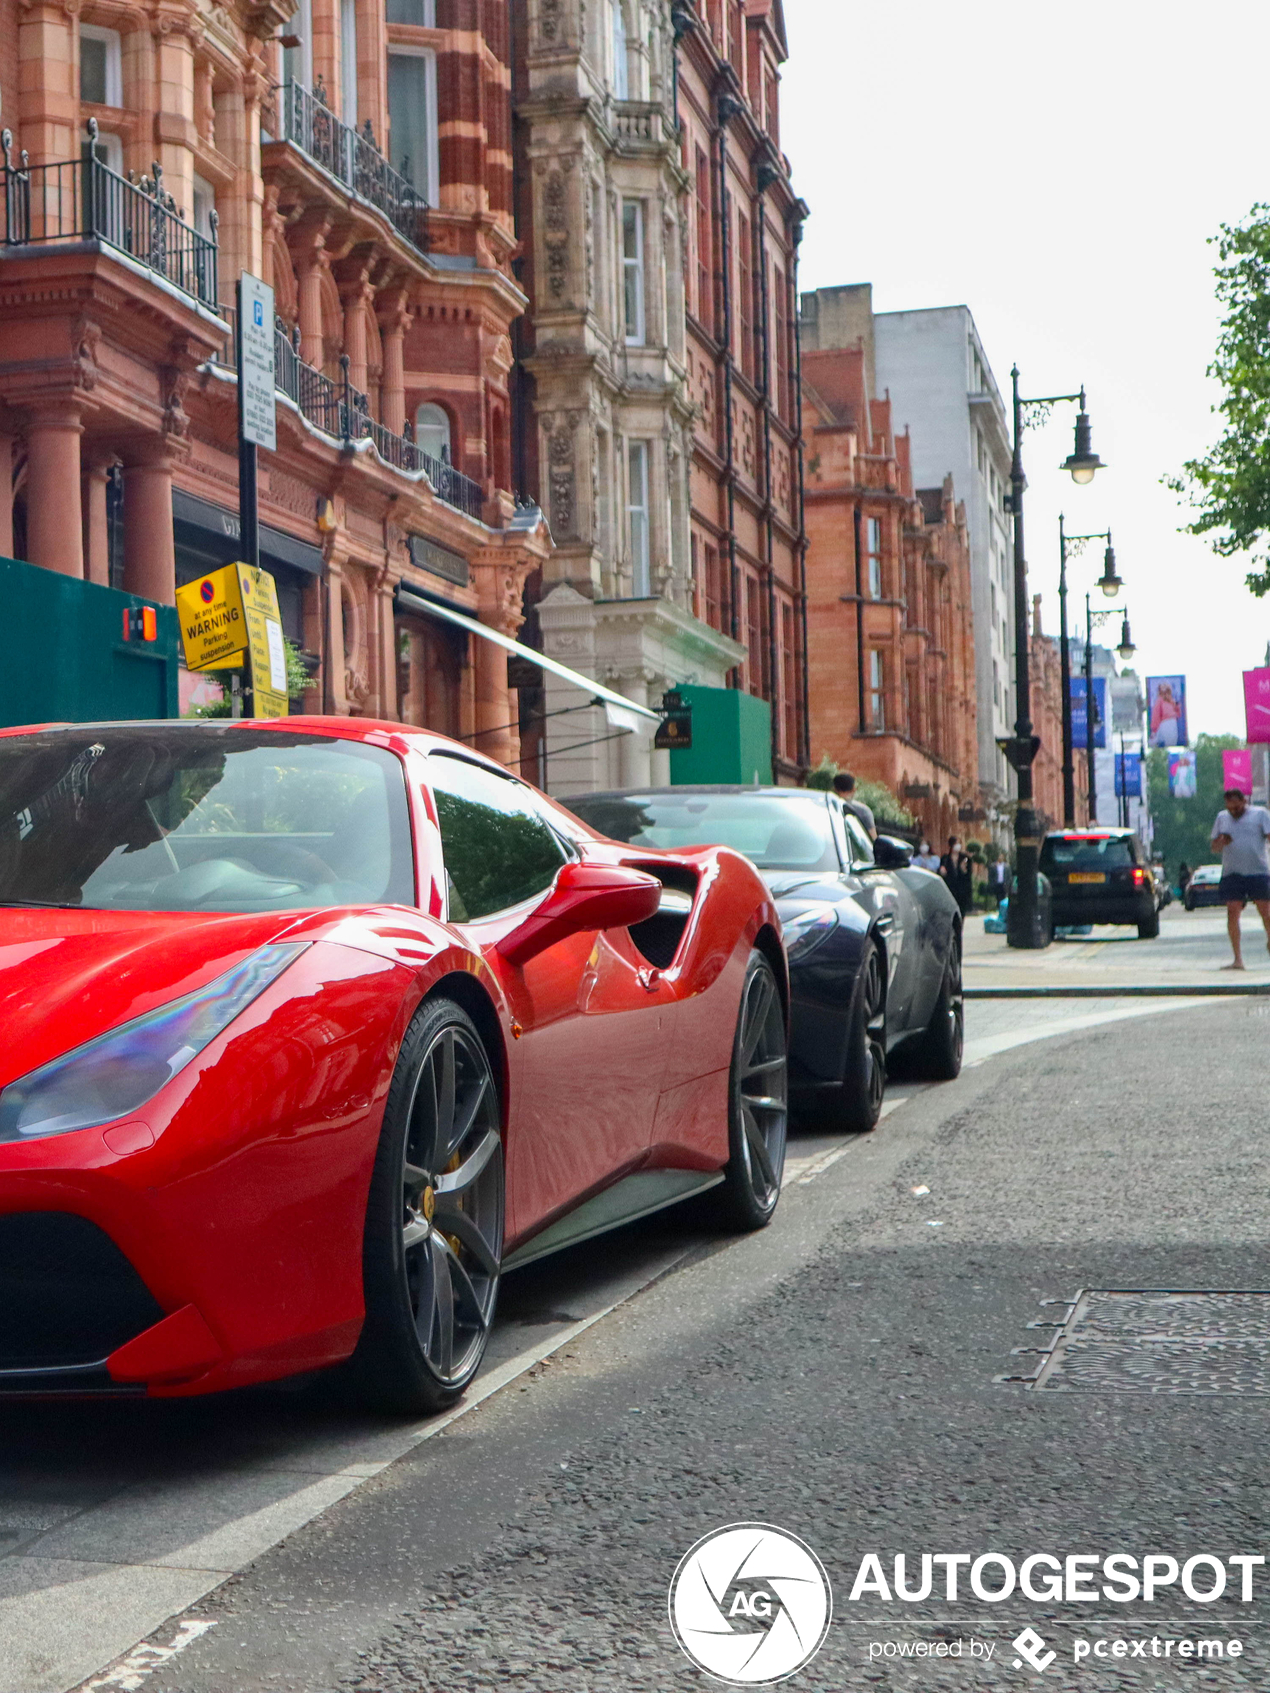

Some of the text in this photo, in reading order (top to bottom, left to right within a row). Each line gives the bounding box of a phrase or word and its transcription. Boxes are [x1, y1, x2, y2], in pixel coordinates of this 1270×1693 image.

[194, 601, 227, 620] at any time
[186, 607, 239, 639] WARNING
[203, 631, 228, 647] Parking
[200, 641, 234, 661] suspension
